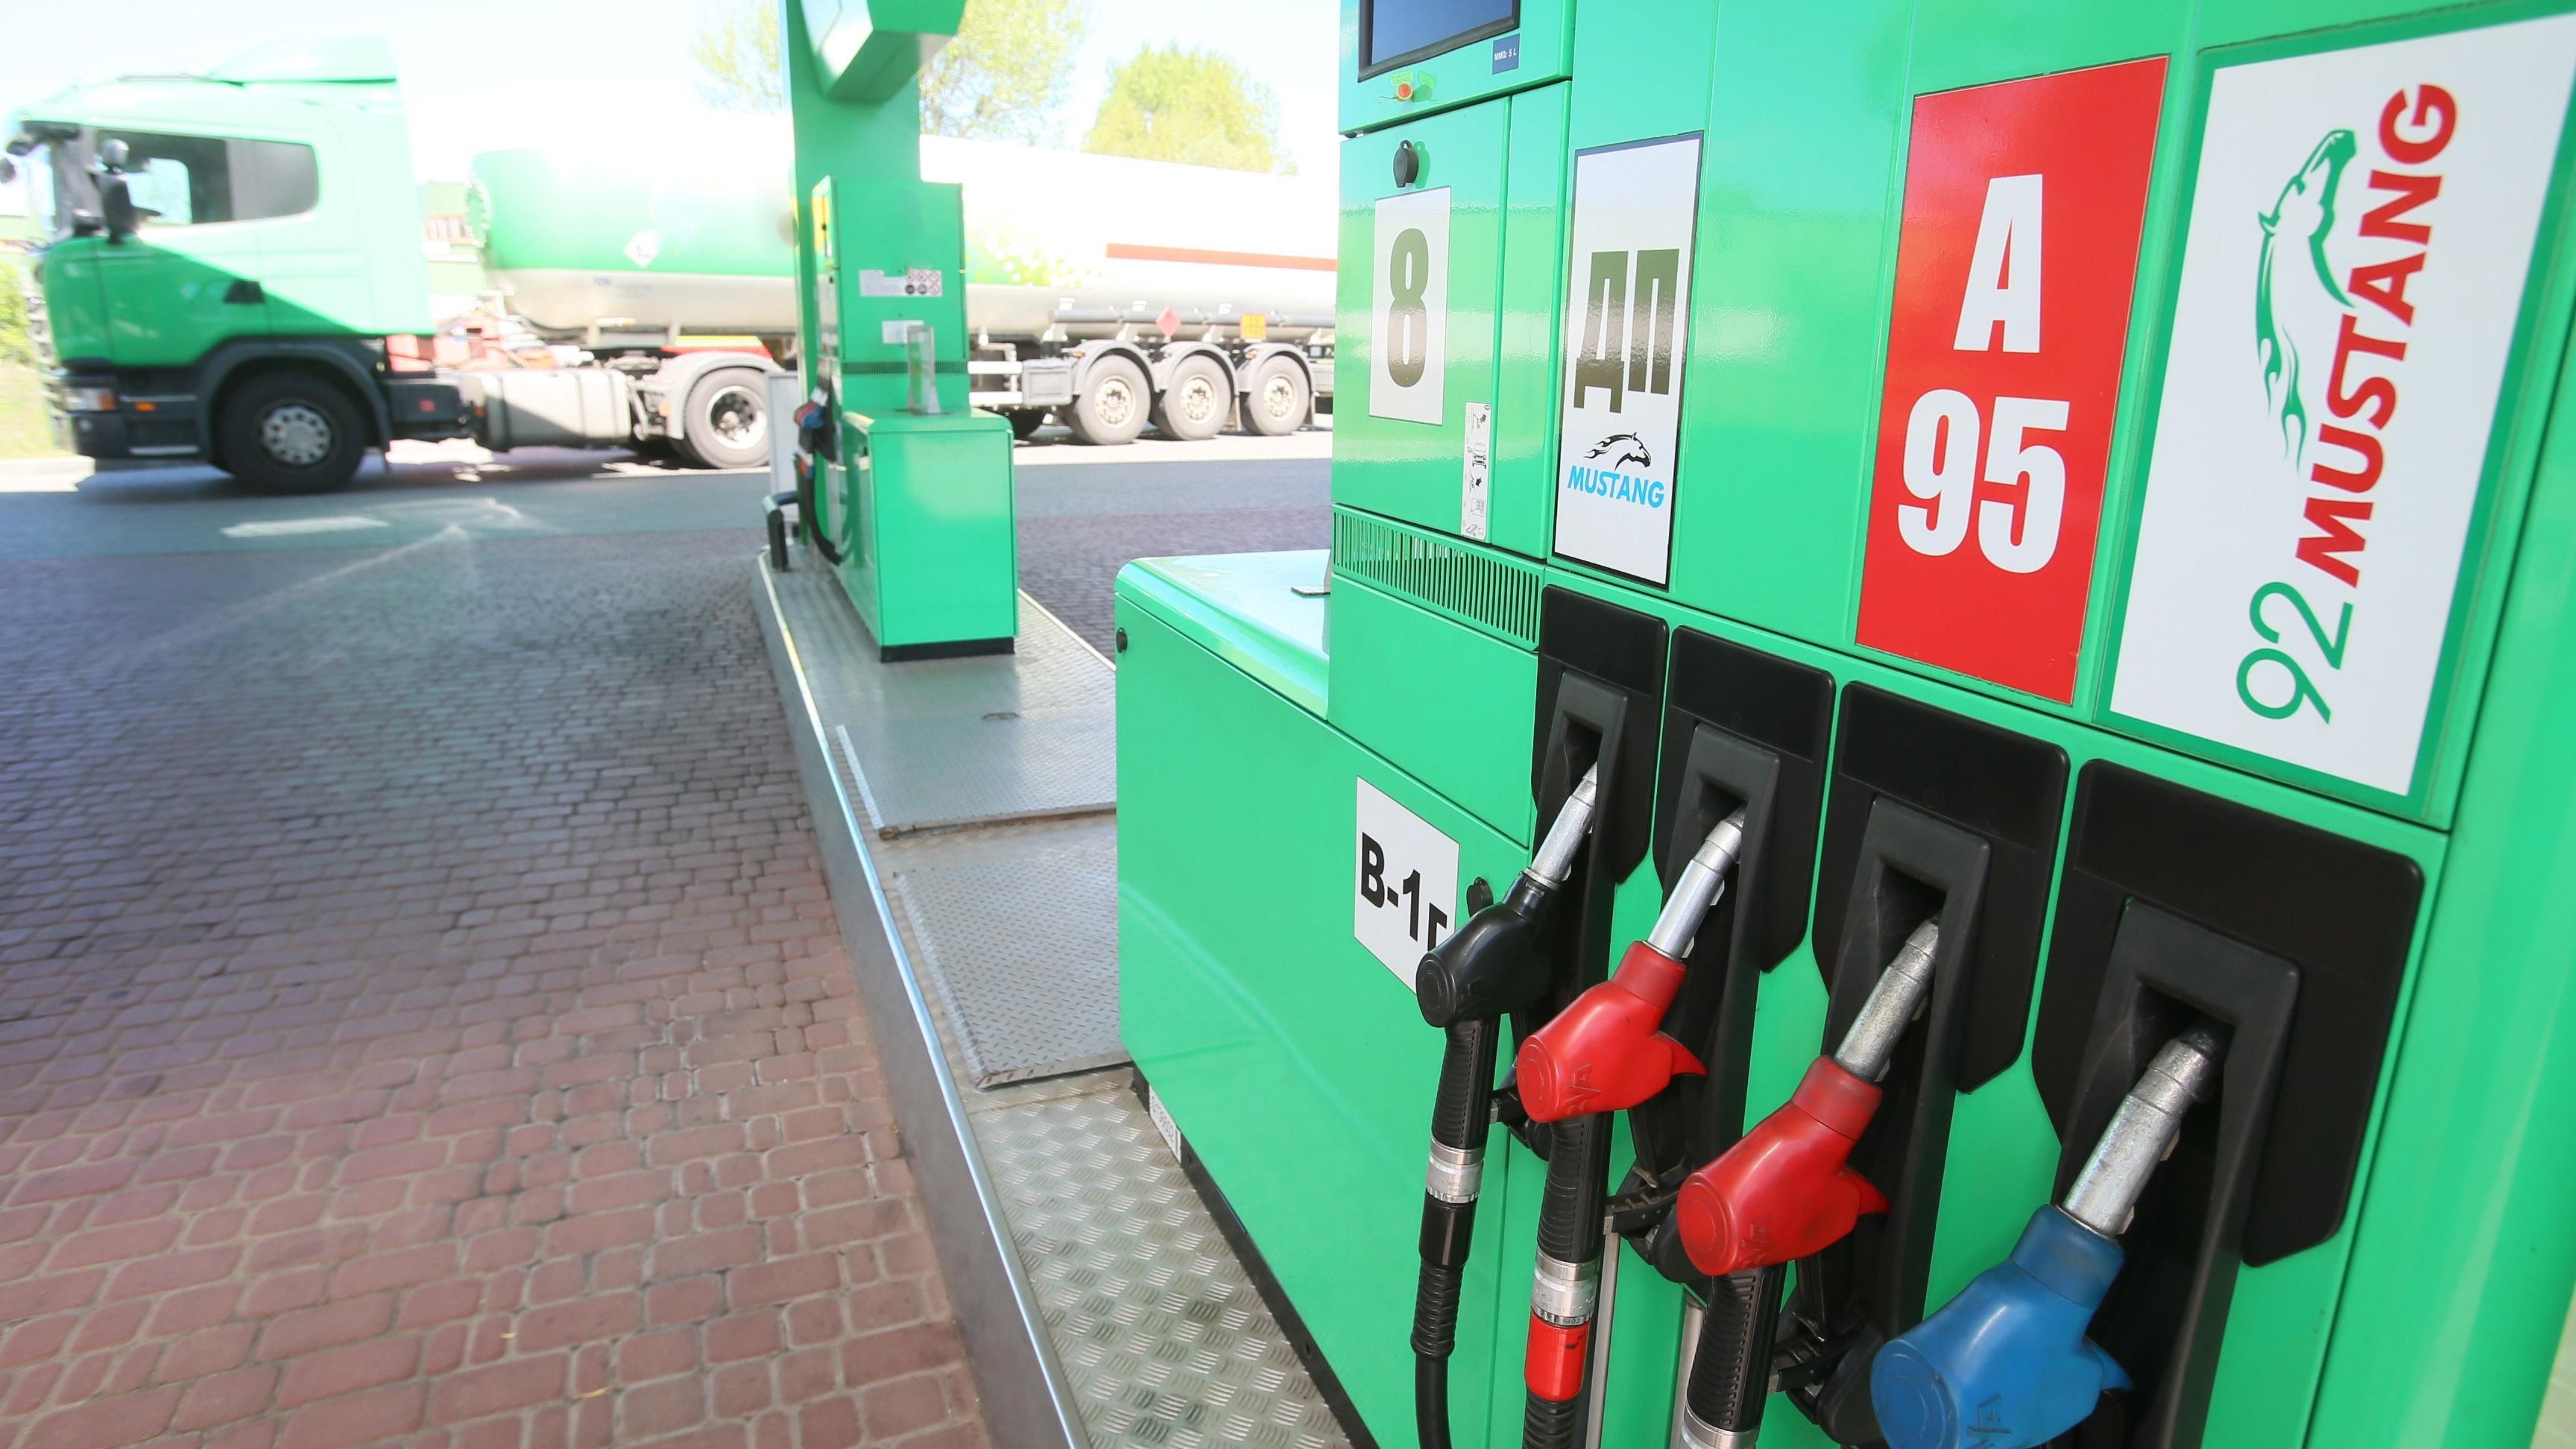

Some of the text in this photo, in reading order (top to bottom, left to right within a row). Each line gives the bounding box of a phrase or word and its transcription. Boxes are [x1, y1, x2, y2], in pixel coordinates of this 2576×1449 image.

[1513, 48, 1517, 56] L
[1387, 228, 1429, 388] 8
[1573, 249, 1679, 414] ДП
[1898, 388, 2069, 574] 95
[2237, 83, 2457, 723] 92 MUSTANG
[1568, 465, 1664, 509] MUSTANG
